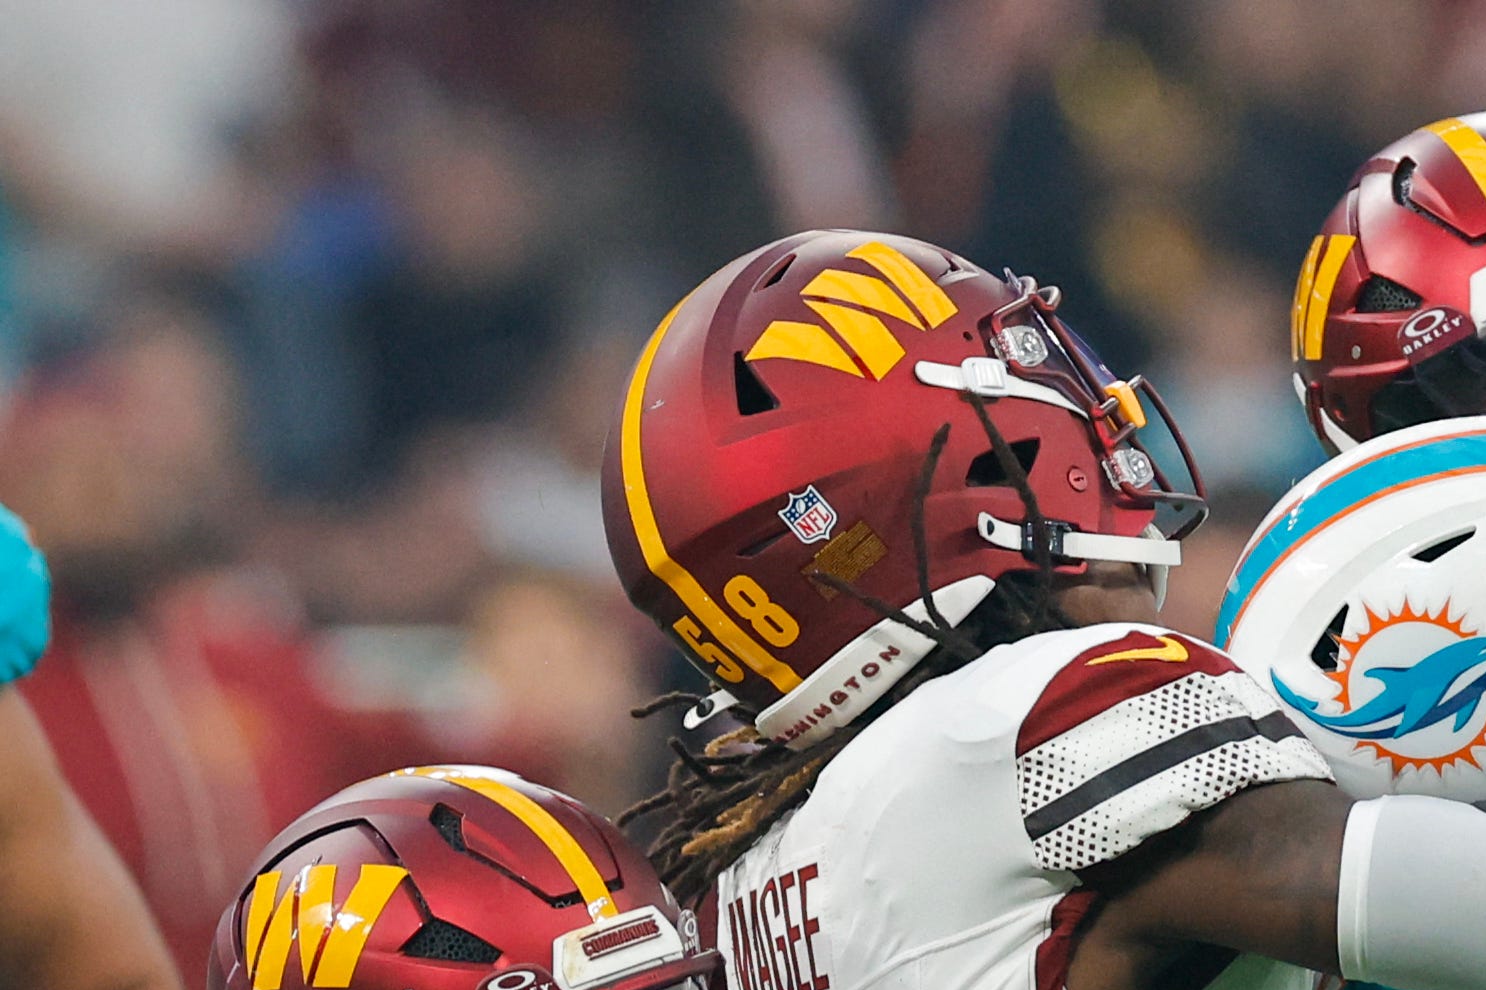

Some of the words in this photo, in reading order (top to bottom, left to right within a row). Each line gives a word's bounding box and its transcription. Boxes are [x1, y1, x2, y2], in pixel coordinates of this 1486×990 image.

[1403, 317, 1462, 355] OAKLEY
[796, 506, 831, 537] NFL
[672, 574, 800, 684] 58
[773, 645, 901, 743] SHINGTON
